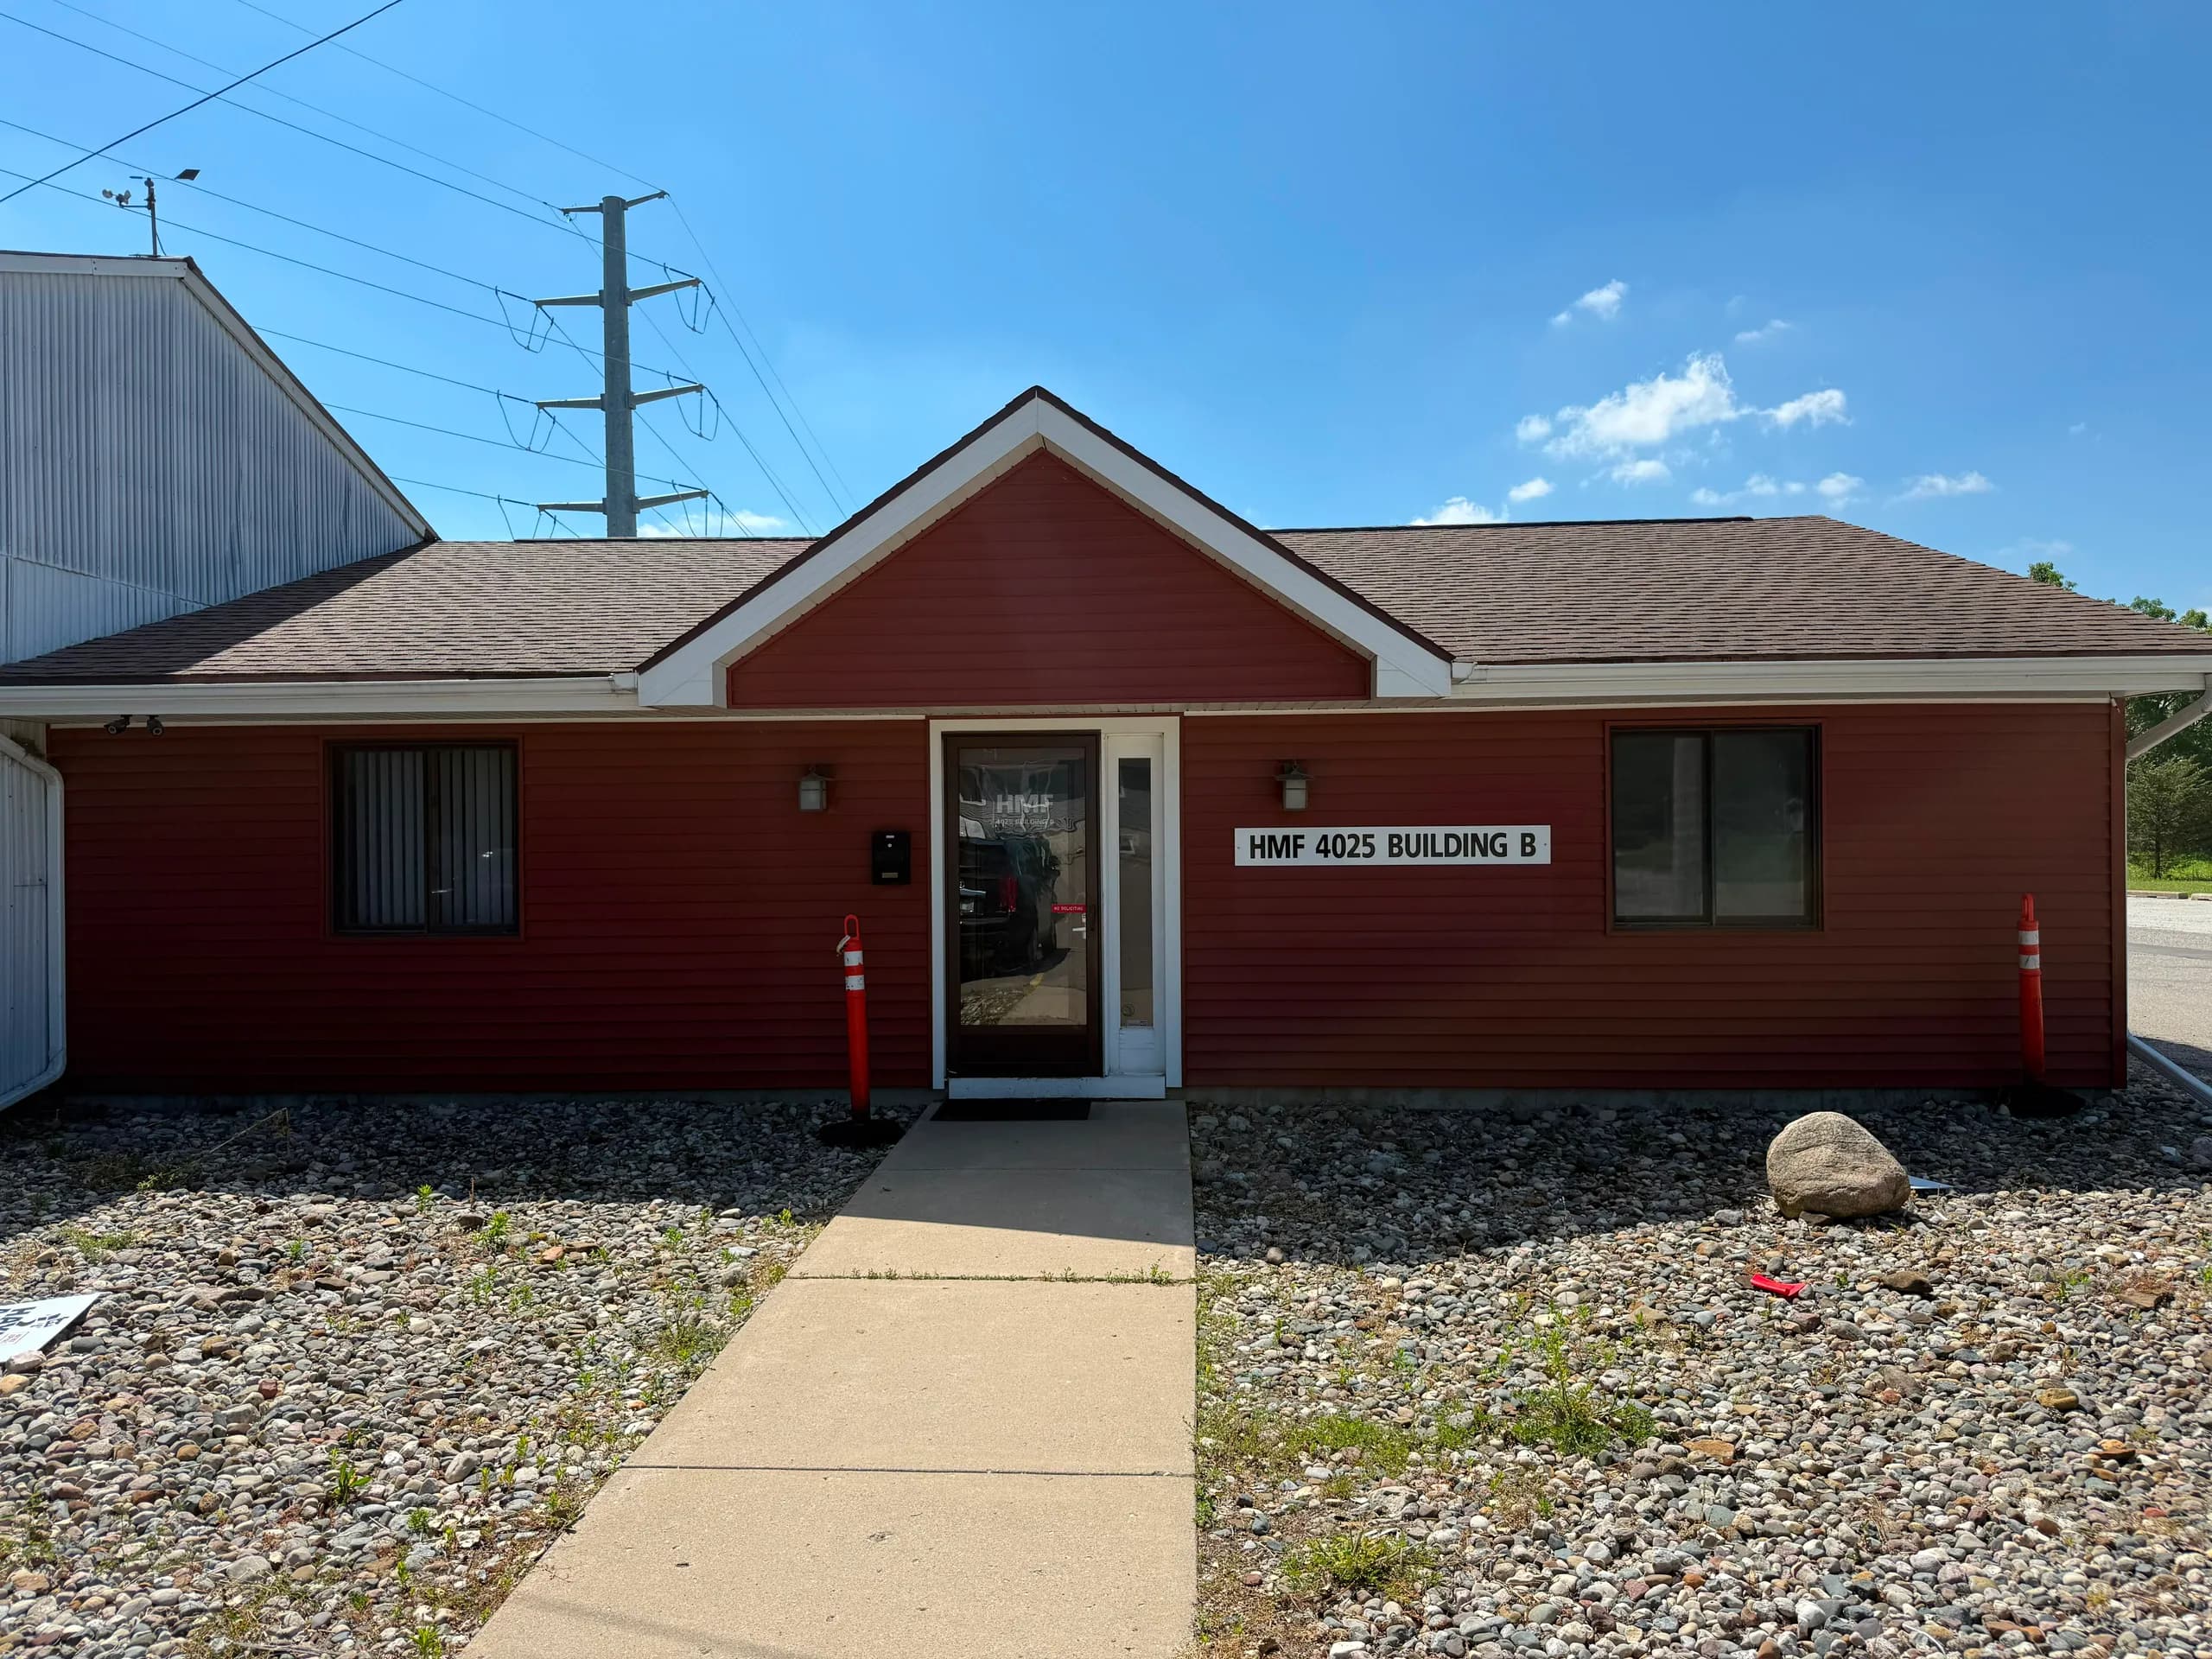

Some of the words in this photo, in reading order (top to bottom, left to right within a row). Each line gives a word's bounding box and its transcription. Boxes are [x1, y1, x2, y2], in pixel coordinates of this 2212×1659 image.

[997, 794, 1053, 813] HMF
[1249, 834, 1306, 859] HMF
[1315, 833, 1376, 859] 4025
[1388, 832, 1508, 858] BUILDING
[1520, 832, 1536, 857] B
